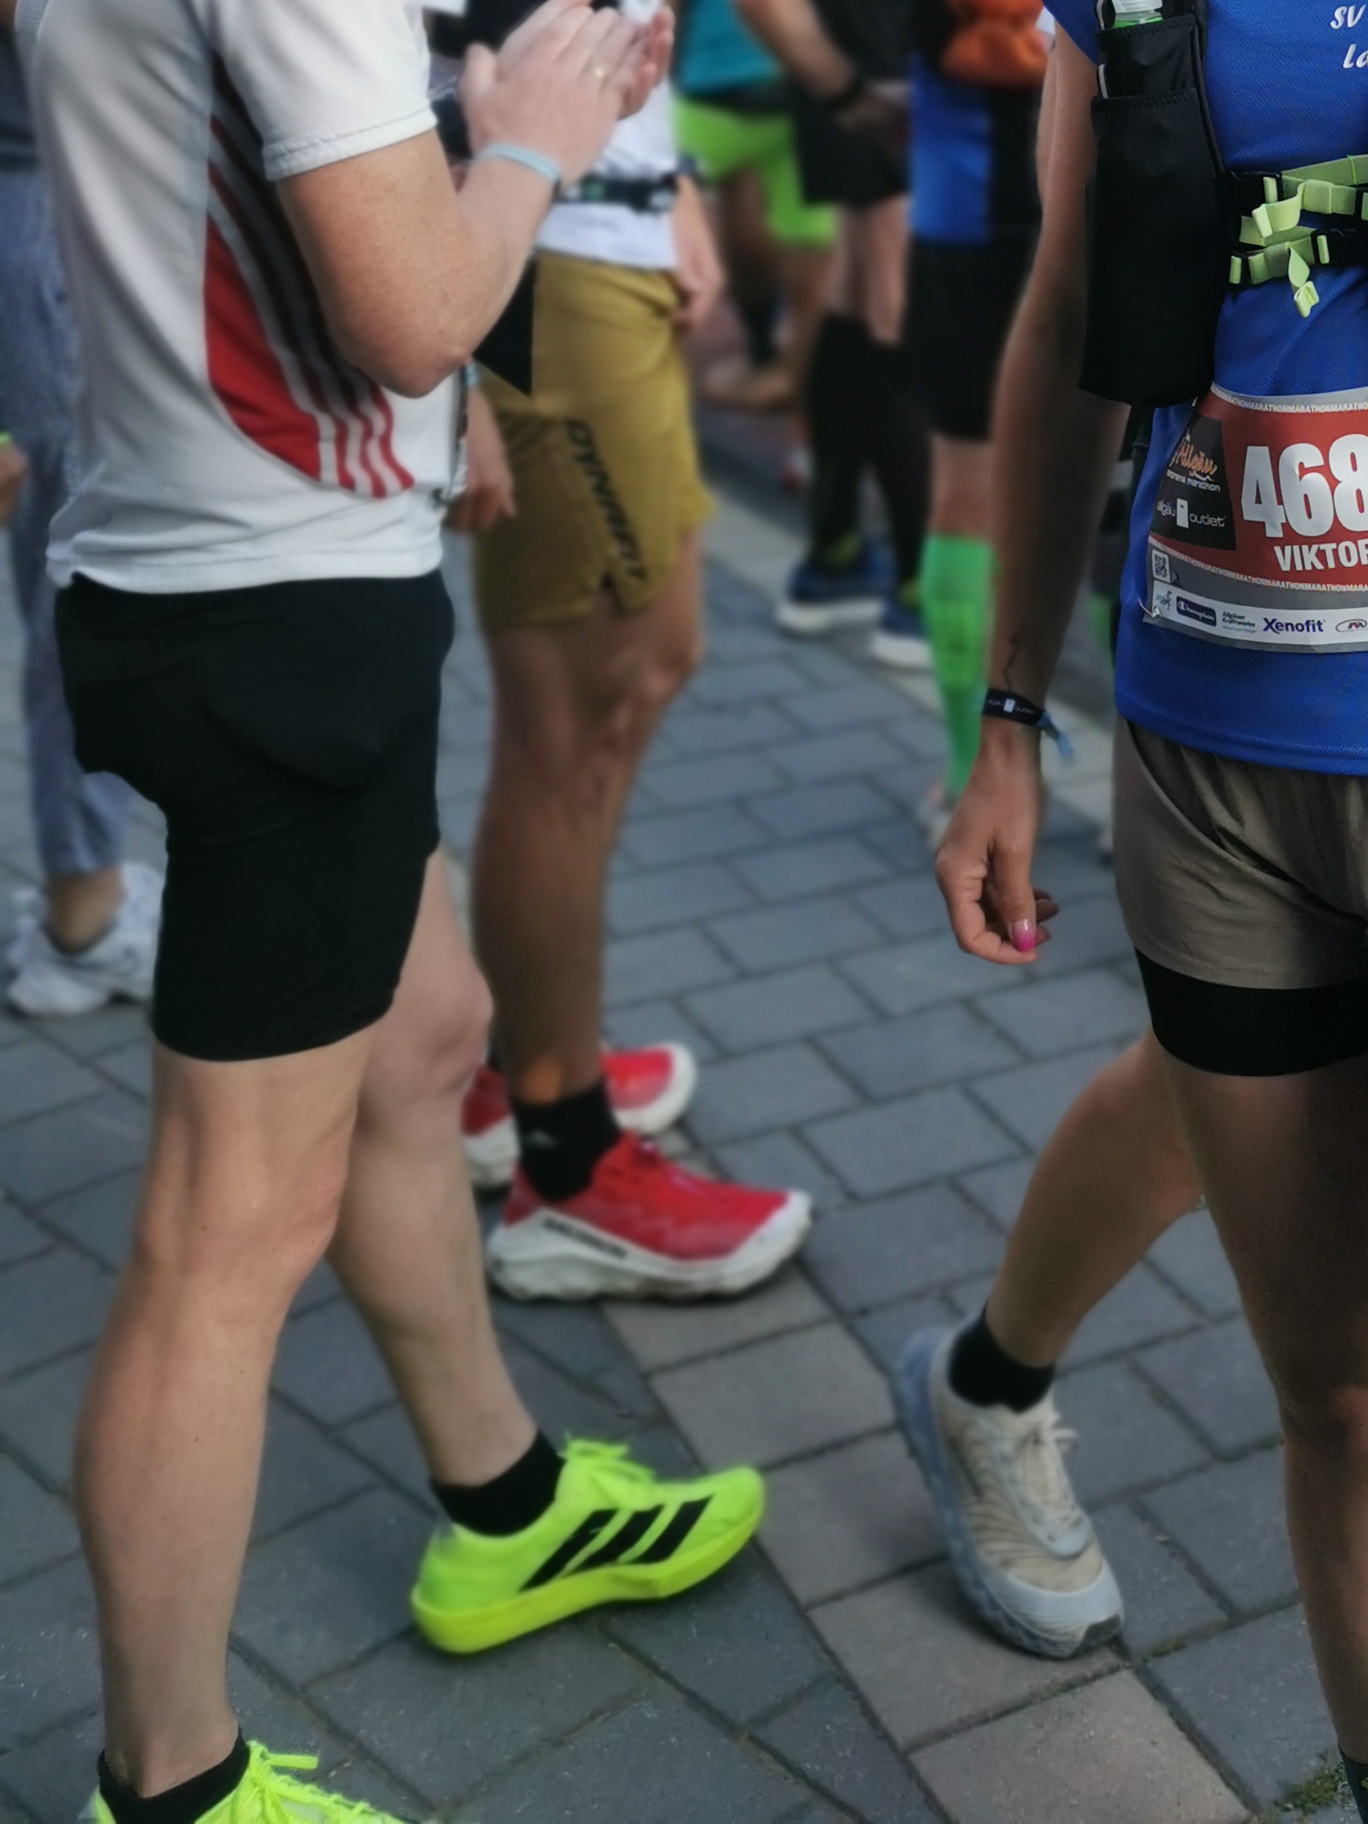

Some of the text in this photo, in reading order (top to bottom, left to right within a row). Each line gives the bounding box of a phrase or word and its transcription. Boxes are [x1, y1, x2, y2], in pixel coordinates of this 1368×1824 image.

[1330, 3, 1367, 30] SV
[1189, 512, 1226, 528] outlet
[1262, 617, 1325, 635] Xenofit
